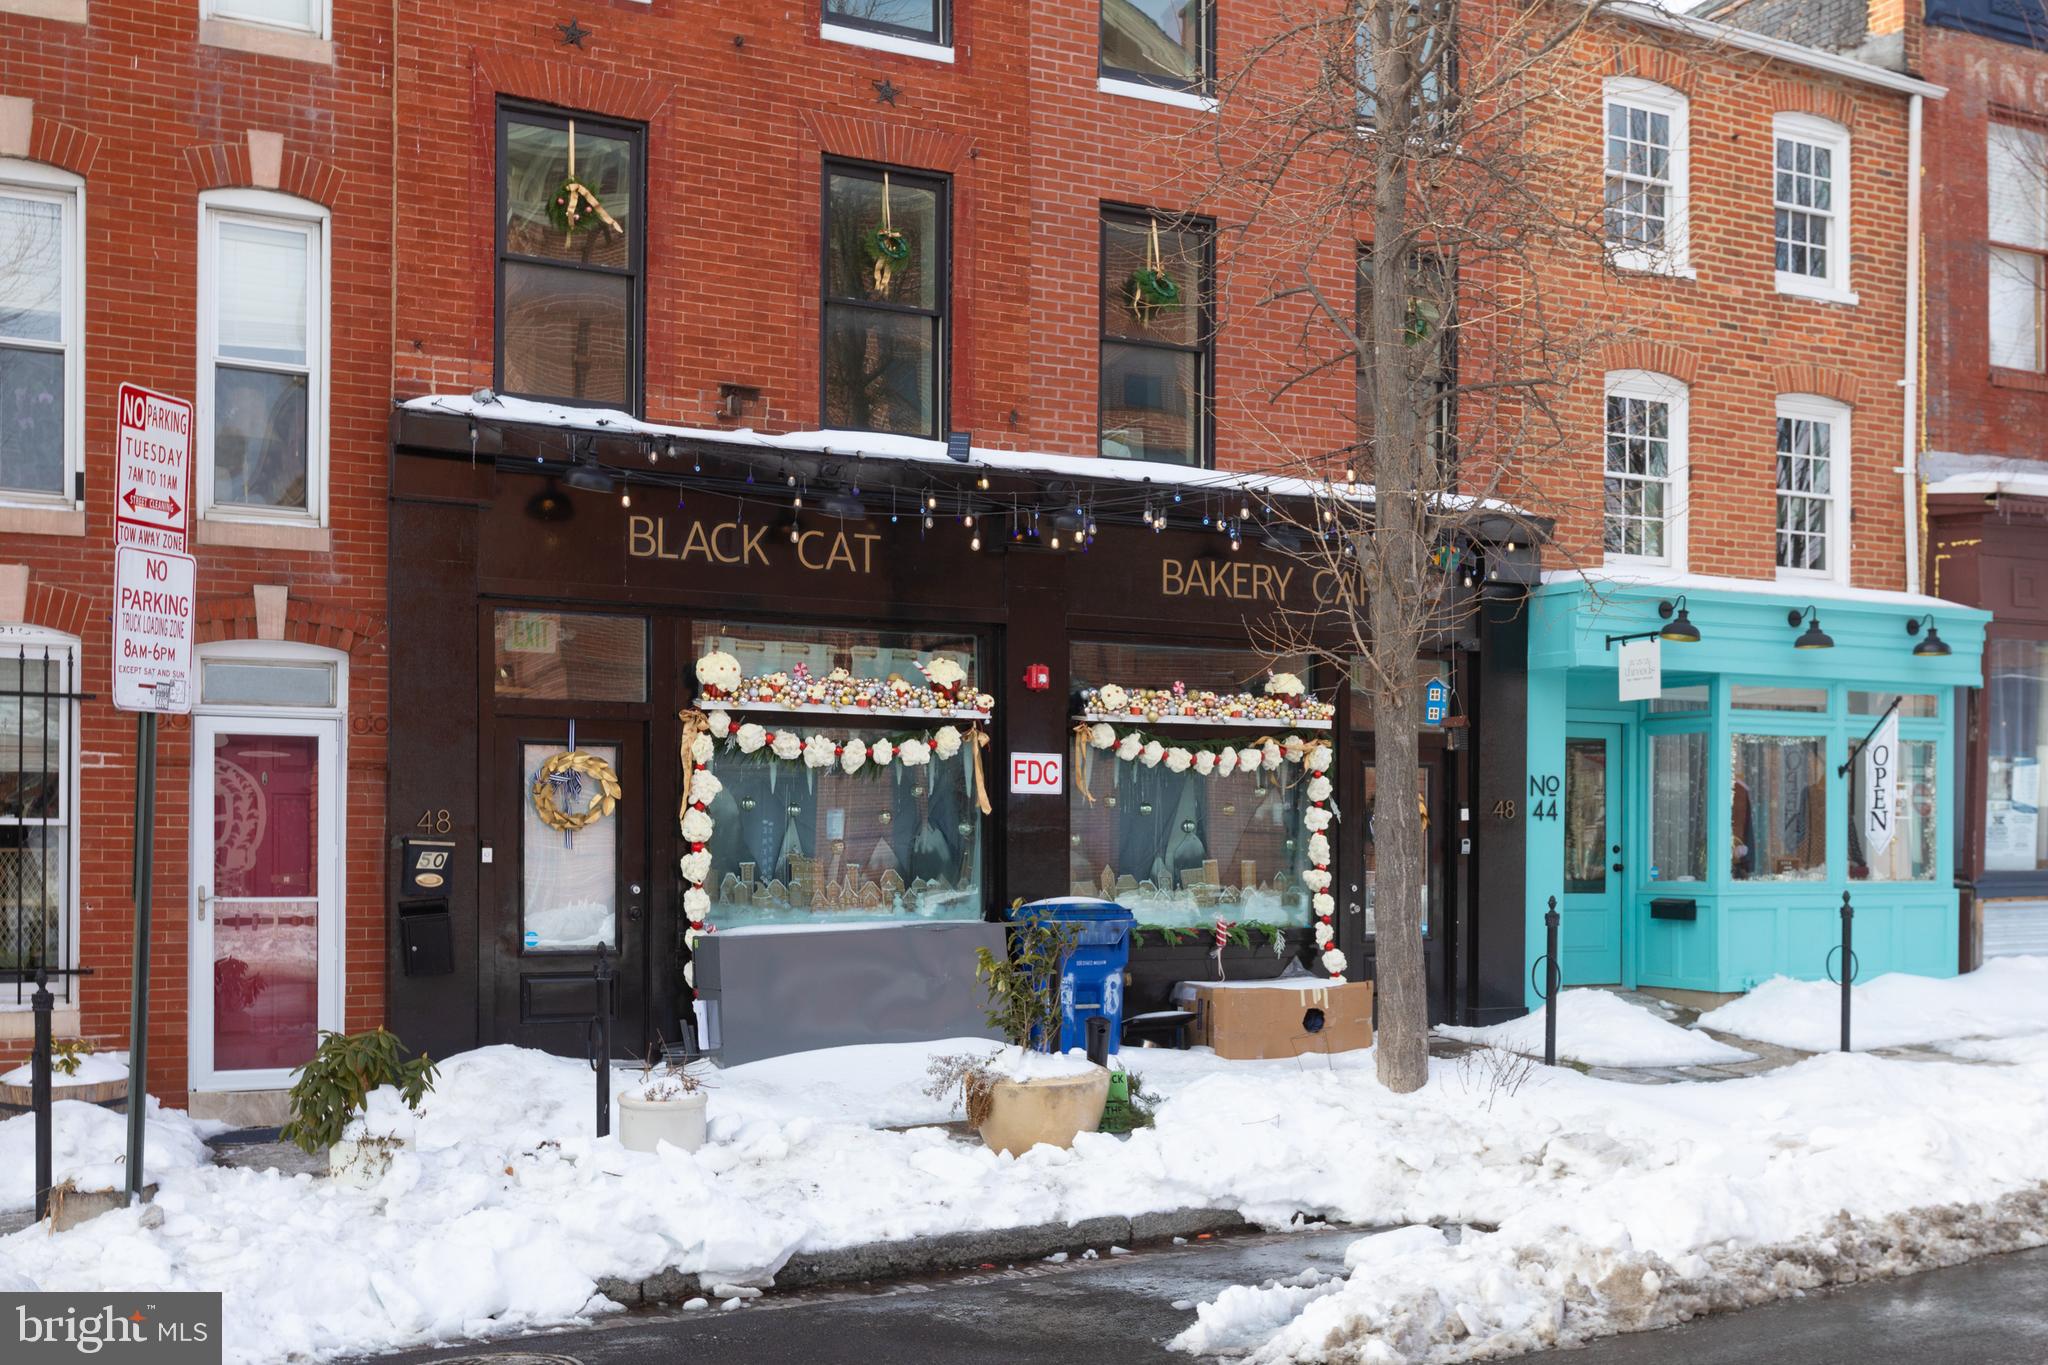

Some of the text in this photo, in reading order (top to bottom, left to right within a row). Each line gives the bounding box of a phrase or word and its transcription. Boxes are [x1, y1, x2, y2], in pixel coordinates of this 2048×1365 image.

[122, 393, 187, 435] NO PARKING
[126, 437, 182, 467] TUESDAY
[128, 466, 178, 490] 7AM TO 11AM
[130, 495, 174, 512] STREET CLEANING
[120, 526, 182, 551] TOW AWAY ZONE
[629, 515, 881, 574] BLACK CAT
[146, 558, 168, 581] NO
[1162, 558, 1294, 601] BAKERY
[121, 587, 189, 617] PARKING
[122, 612, 184, 639] TRUCK LOADING ZONE
[124, 638, 176, 661] 8AM-6PM
[118, 664, 185, 679] EXCEPT SAT AND SUN
[1014, 759, 1059, 785] FDC
[1870, 745, 1889, 832] OPEN
[417, 809, 451, 834] 48
[1492, 800, 1515, 819] 48
[1532, 799, 1559, 821] 44
[419, 852, 445, 868] 50
